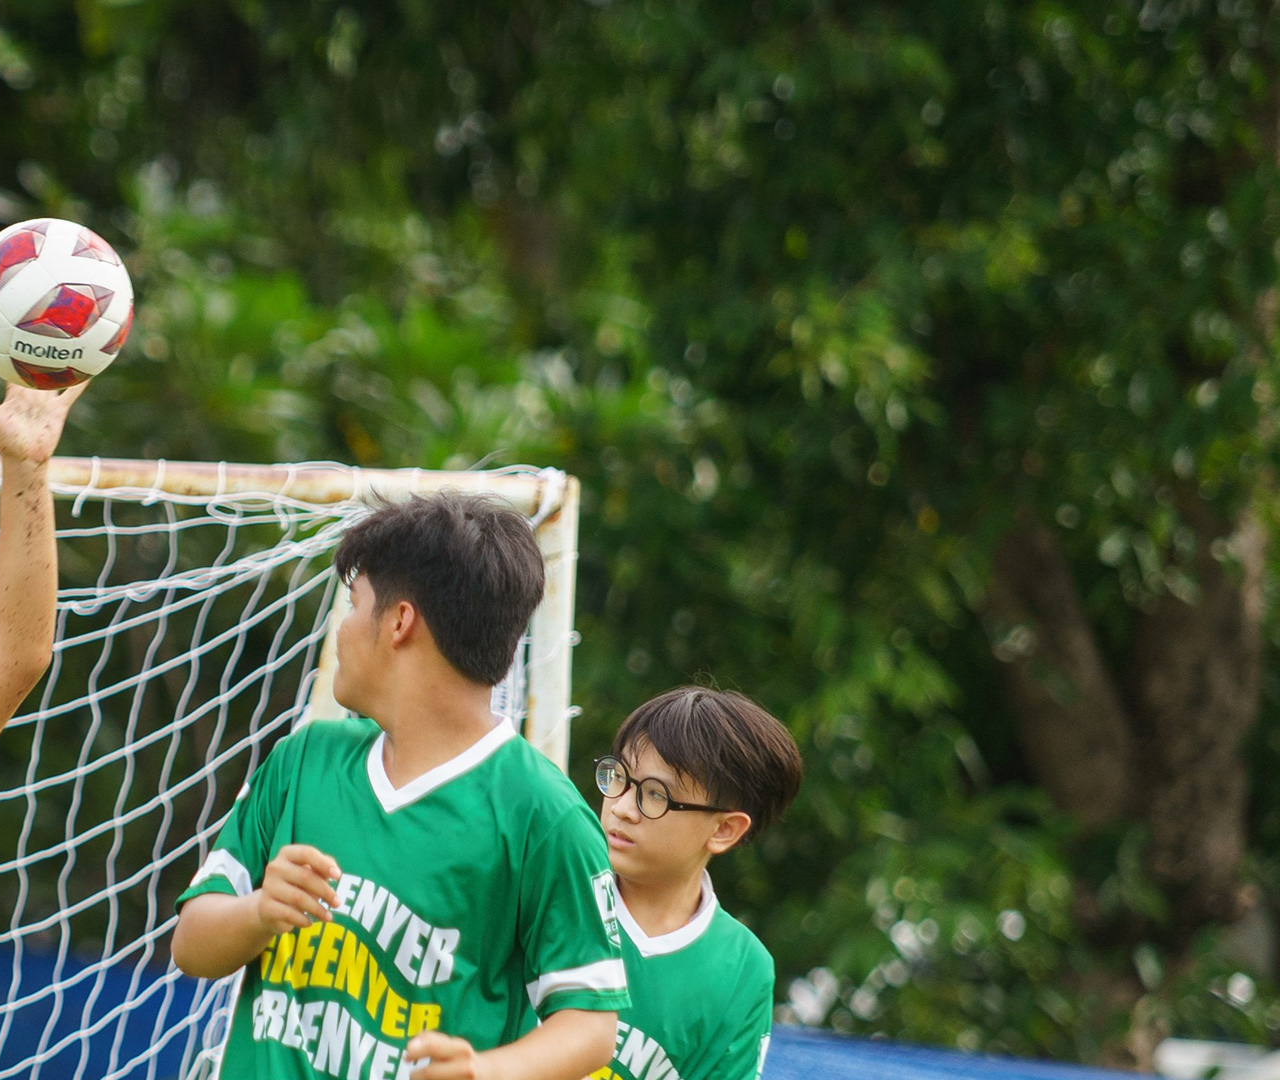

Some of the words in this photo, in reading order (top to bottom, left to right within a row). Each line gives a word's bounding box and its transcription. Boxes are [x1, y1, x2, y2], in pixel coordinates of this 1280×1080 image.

[14, 340, 83, 359] molten
[260, 921, 441, 1038] GREENYER
[304, 873, 460, 988] ENYER
